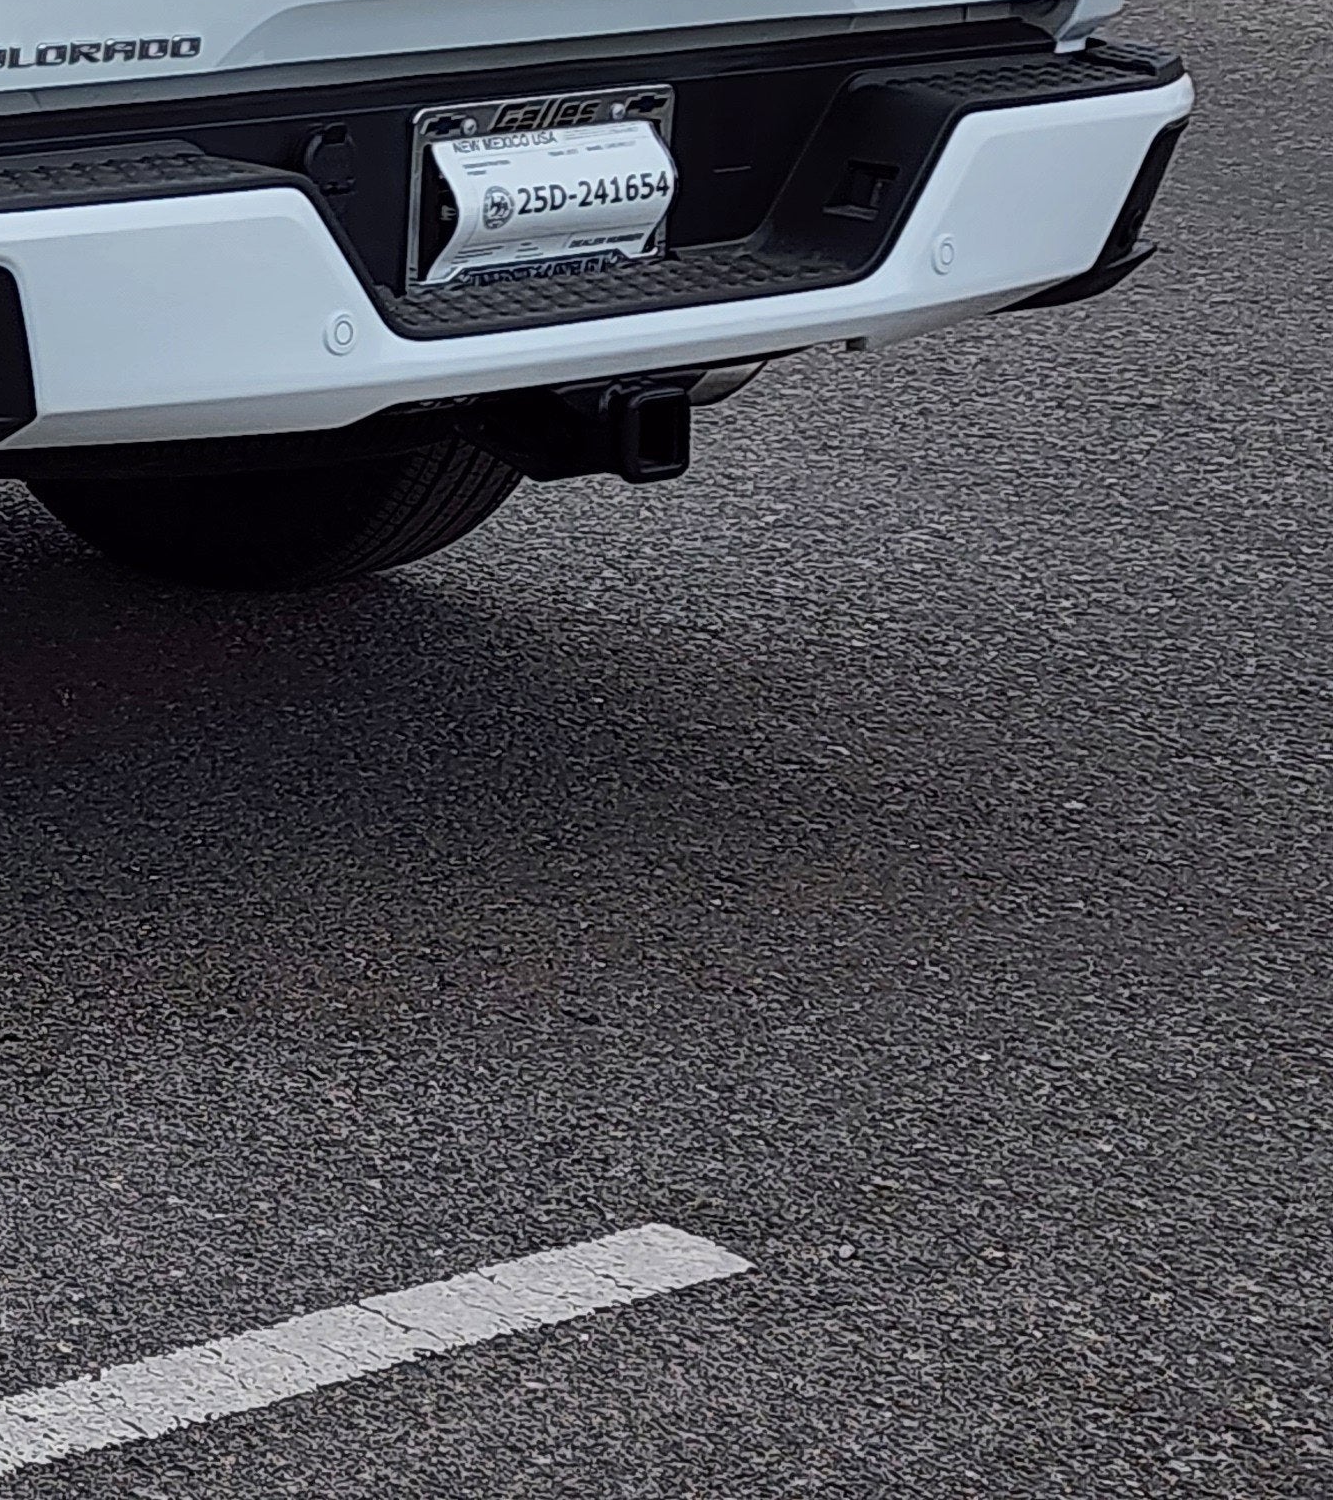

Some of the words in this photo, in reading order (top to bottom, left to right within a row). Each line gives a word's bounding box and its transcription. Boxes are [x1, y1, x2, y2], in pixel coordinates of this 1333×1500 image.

[452, 140, 480, 154] NEW
[482, 133, 531, 151] MEXICO
[532, 131, 558, 147] USA
[517, 170, 670, 216] 25D-241654
